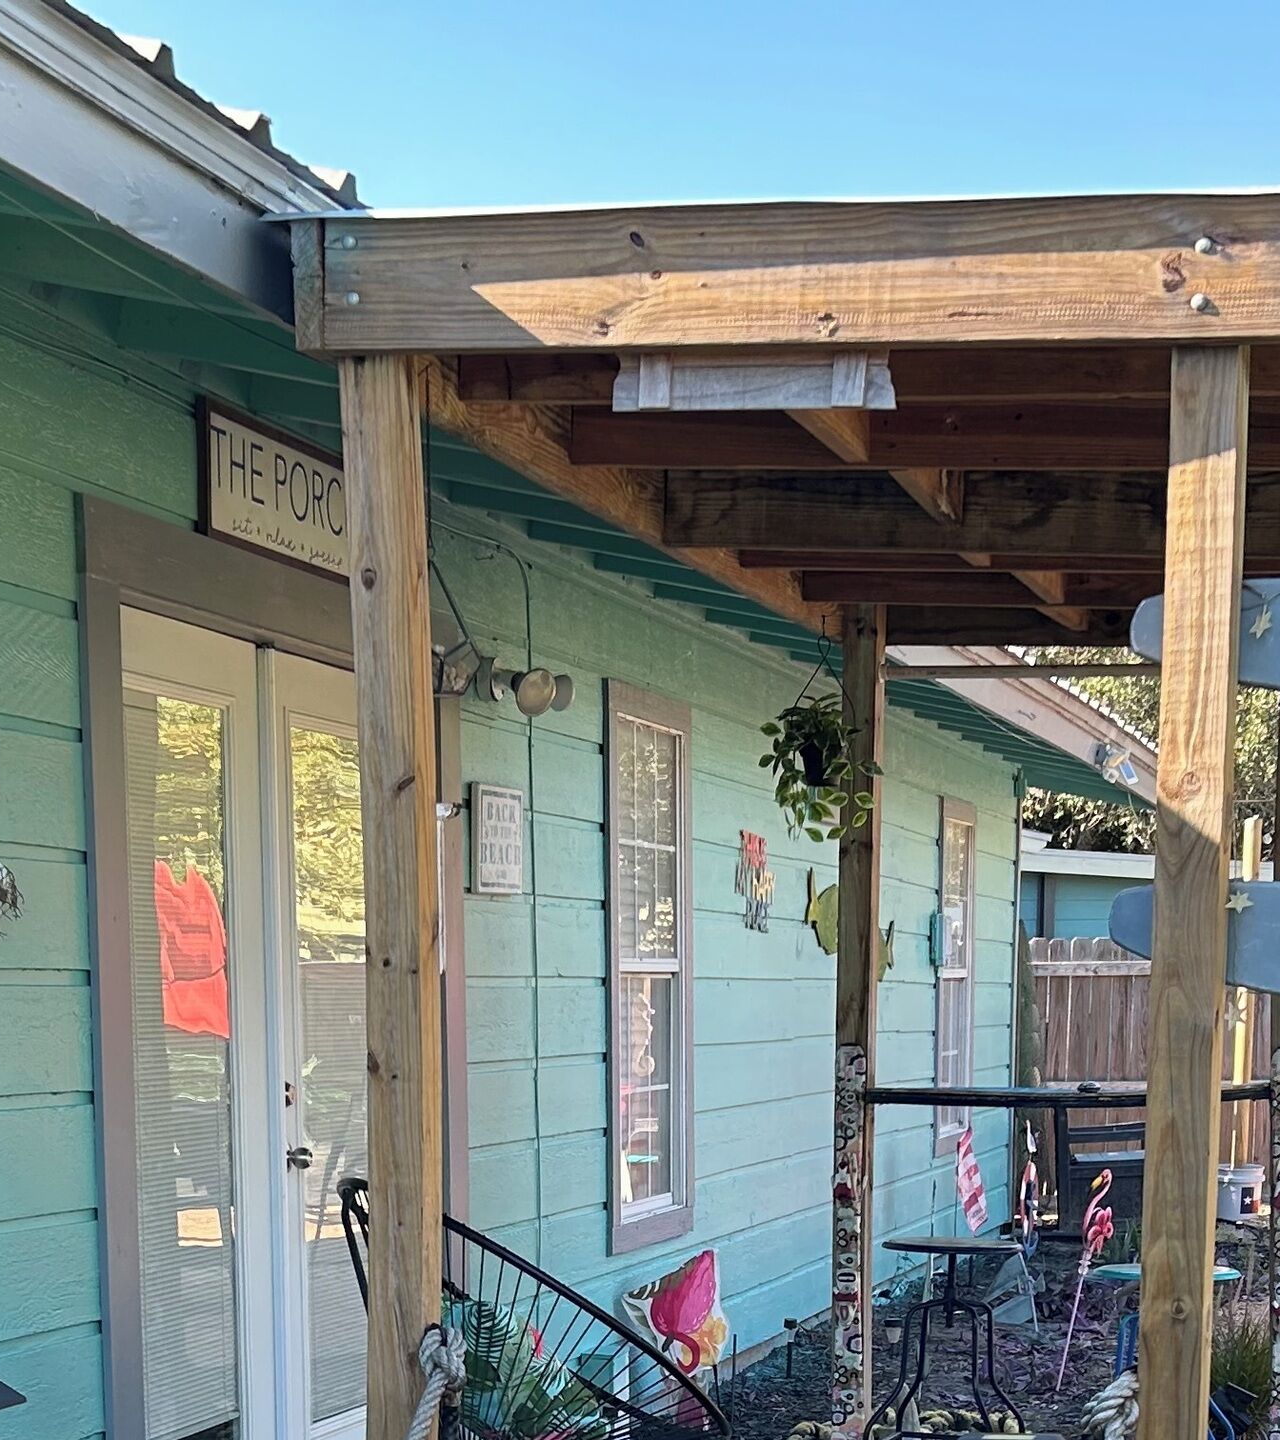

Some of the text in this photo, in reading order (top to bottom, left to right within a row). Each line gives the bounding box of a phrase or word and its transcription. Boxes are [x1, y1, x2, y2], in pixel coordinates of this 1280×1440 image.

[211, 426, 348, 538] THE PORC
[487, 802, 516, 823] BACK
